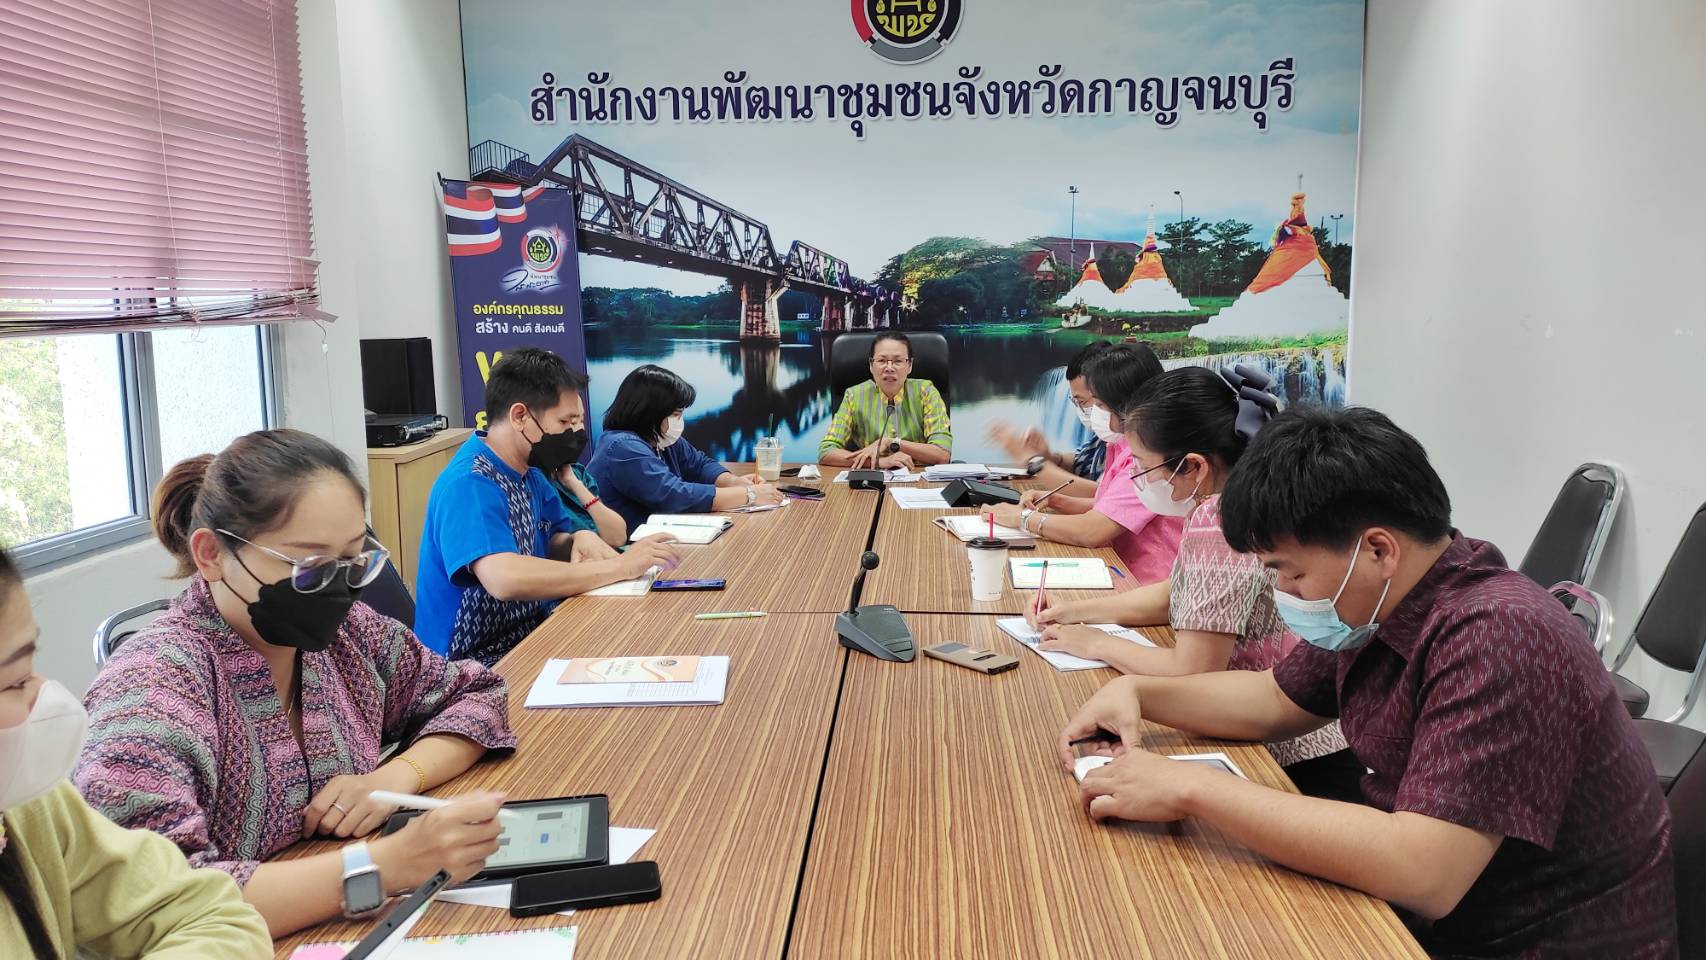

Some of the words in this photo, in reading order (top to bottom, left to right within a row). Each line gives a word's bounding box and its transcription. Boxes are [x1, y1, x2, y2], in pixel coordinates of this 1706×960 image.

[530, 57, 1295, 138] สำนักงานพัฒนาชุมชนจังหวัดกาญจนบุรี
[473, 301, 564, 319] องค์กรคุณธรรม
[475, 318, 509, 334] สร้าง
[512, 323, 532, 333] คนดี
[534, 322, 565, 333] สังคมดี
